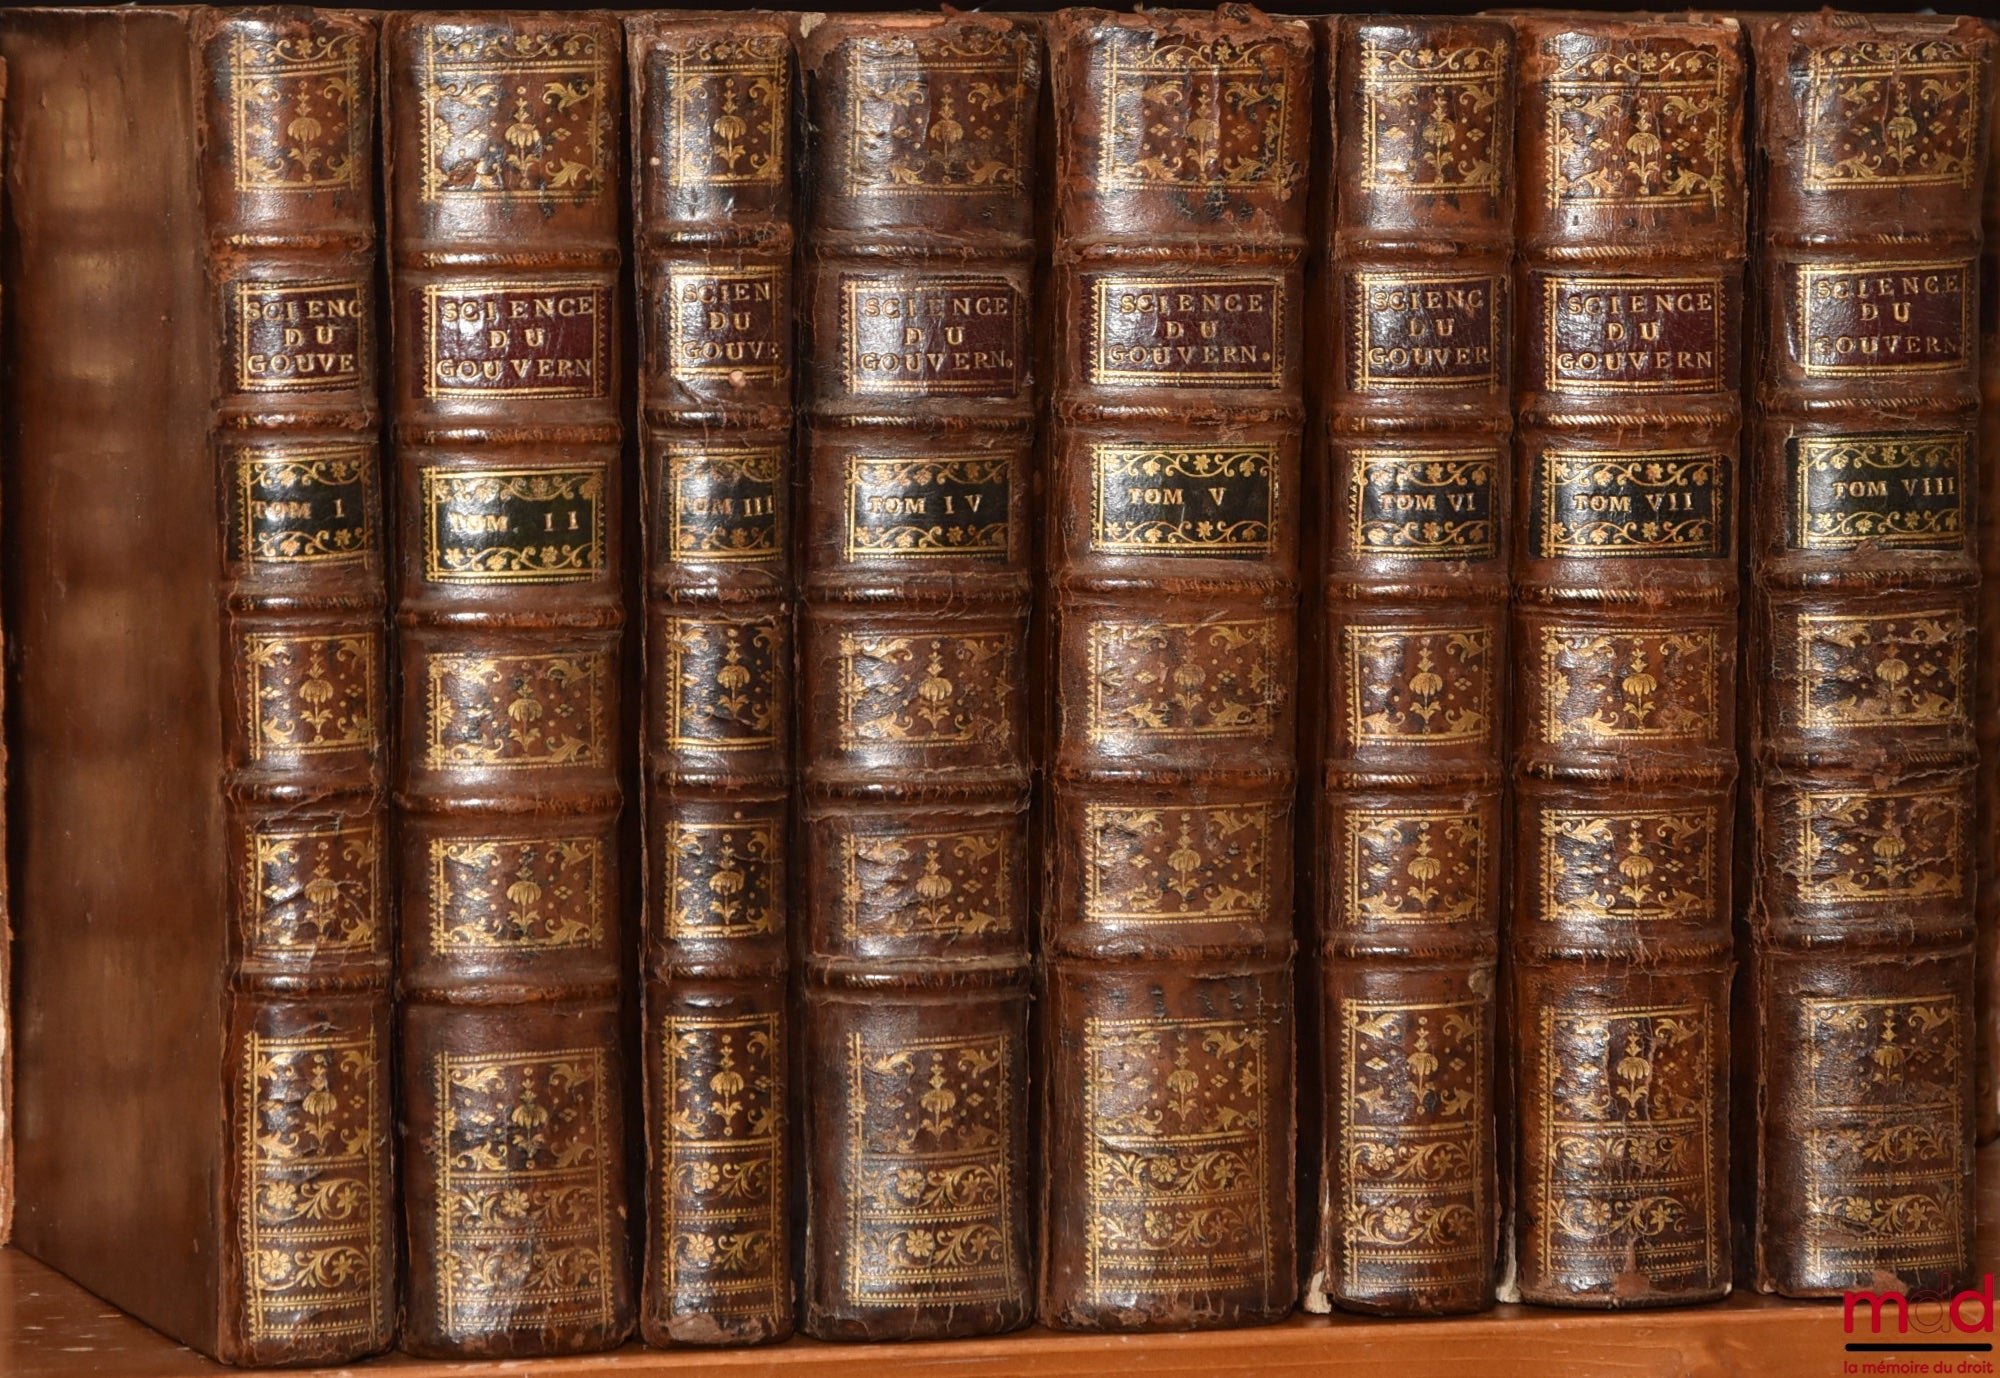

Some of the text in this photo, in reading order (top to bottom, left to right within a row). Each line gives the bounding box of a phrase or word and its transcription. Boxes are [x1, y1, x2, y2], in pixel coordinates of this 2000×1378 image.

[682, 284, 771, 303] SCIEN
[1817, 275, 1958, 299] SCIENCE
[442, 297, 593, 322] SCIENCE
[864, 298, 1008, 319] SCIENCE
[1120, 293, 1264, 315] SCIENCE
[1373, 289, 1483, 311] SCIENC
[1567, 293, 1712, 316] SCIENCE
[710, 312, 750, 331] DU
[1861, 302, 1912, 322] DU
[285, 329, 334, 348] DU
[490, 328, 544, 349] DU
[905, 326, 965, 346] DU
[1166, 320, 1217, 340] DU
[1409, 319, 1455, 338] DU
[1607, 322, 1660, 341] DU
[682, 341, 780, 360] GOUVE
[1814, 335, 1958, 356] GOUVERN
[248, 353, 354, 373] GOUVE
[860, 351, 1014, 372] GOUVERN.
[1369, 347, 1490, 366] GOUVER
[1558, 351, 1712, 372] GOUVERN
[437, 358, 592, 380] GOUVERN
[1127, 487, 1226, 506] TOM V
[1832, 476, 1955, 498] TOM VIII
[252, 499, 344, 520] TOM I
[678, 495, 774, 517] TOM III
[870, 497, 927, 514] TOM
[1379, 493, 1476, 512] TOM VI
[1574, 492, 1693, 513] TOM VII
[451, 513, 508, 533] TOM
